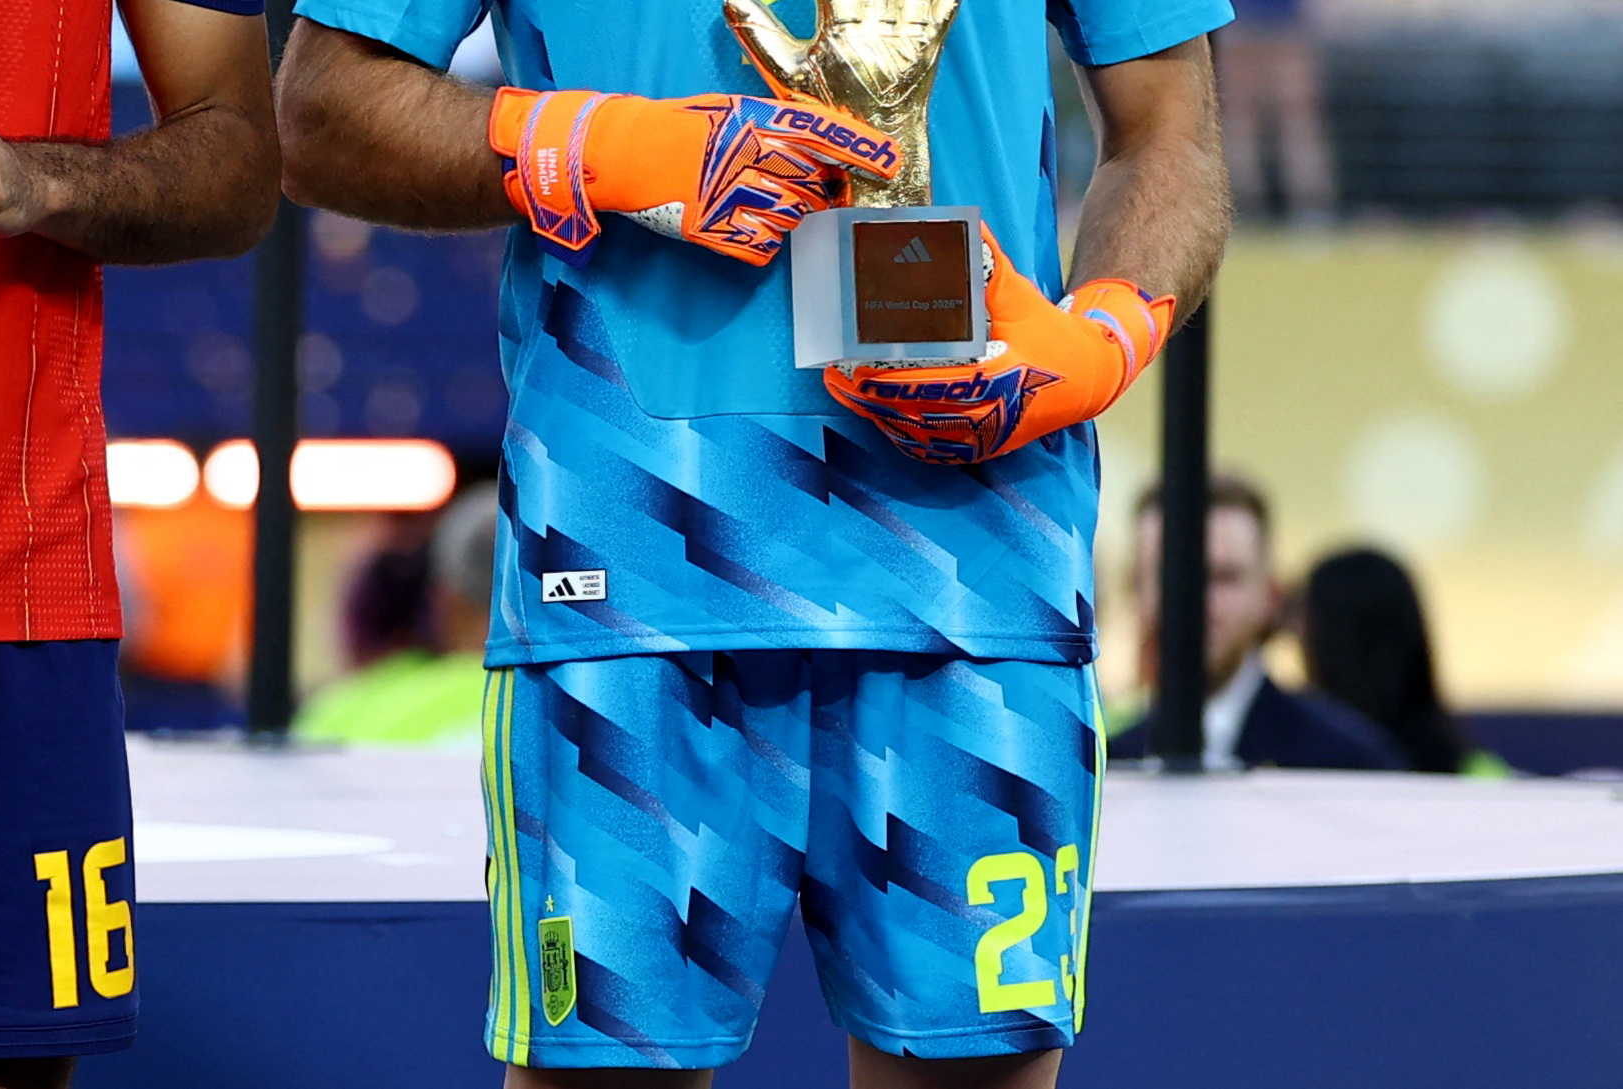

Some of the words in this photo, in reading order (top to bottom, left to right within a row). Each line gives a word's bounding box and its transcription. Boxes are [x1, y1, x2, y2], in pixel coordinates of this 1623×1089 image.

[773, 106, 896, 169] reusch
[547, 147, 559, 183] UNAI
[912, 300, 929, 311] Cup
[859, 371, 991, 401] reusch
[33, 836, 135, 1009] 16
